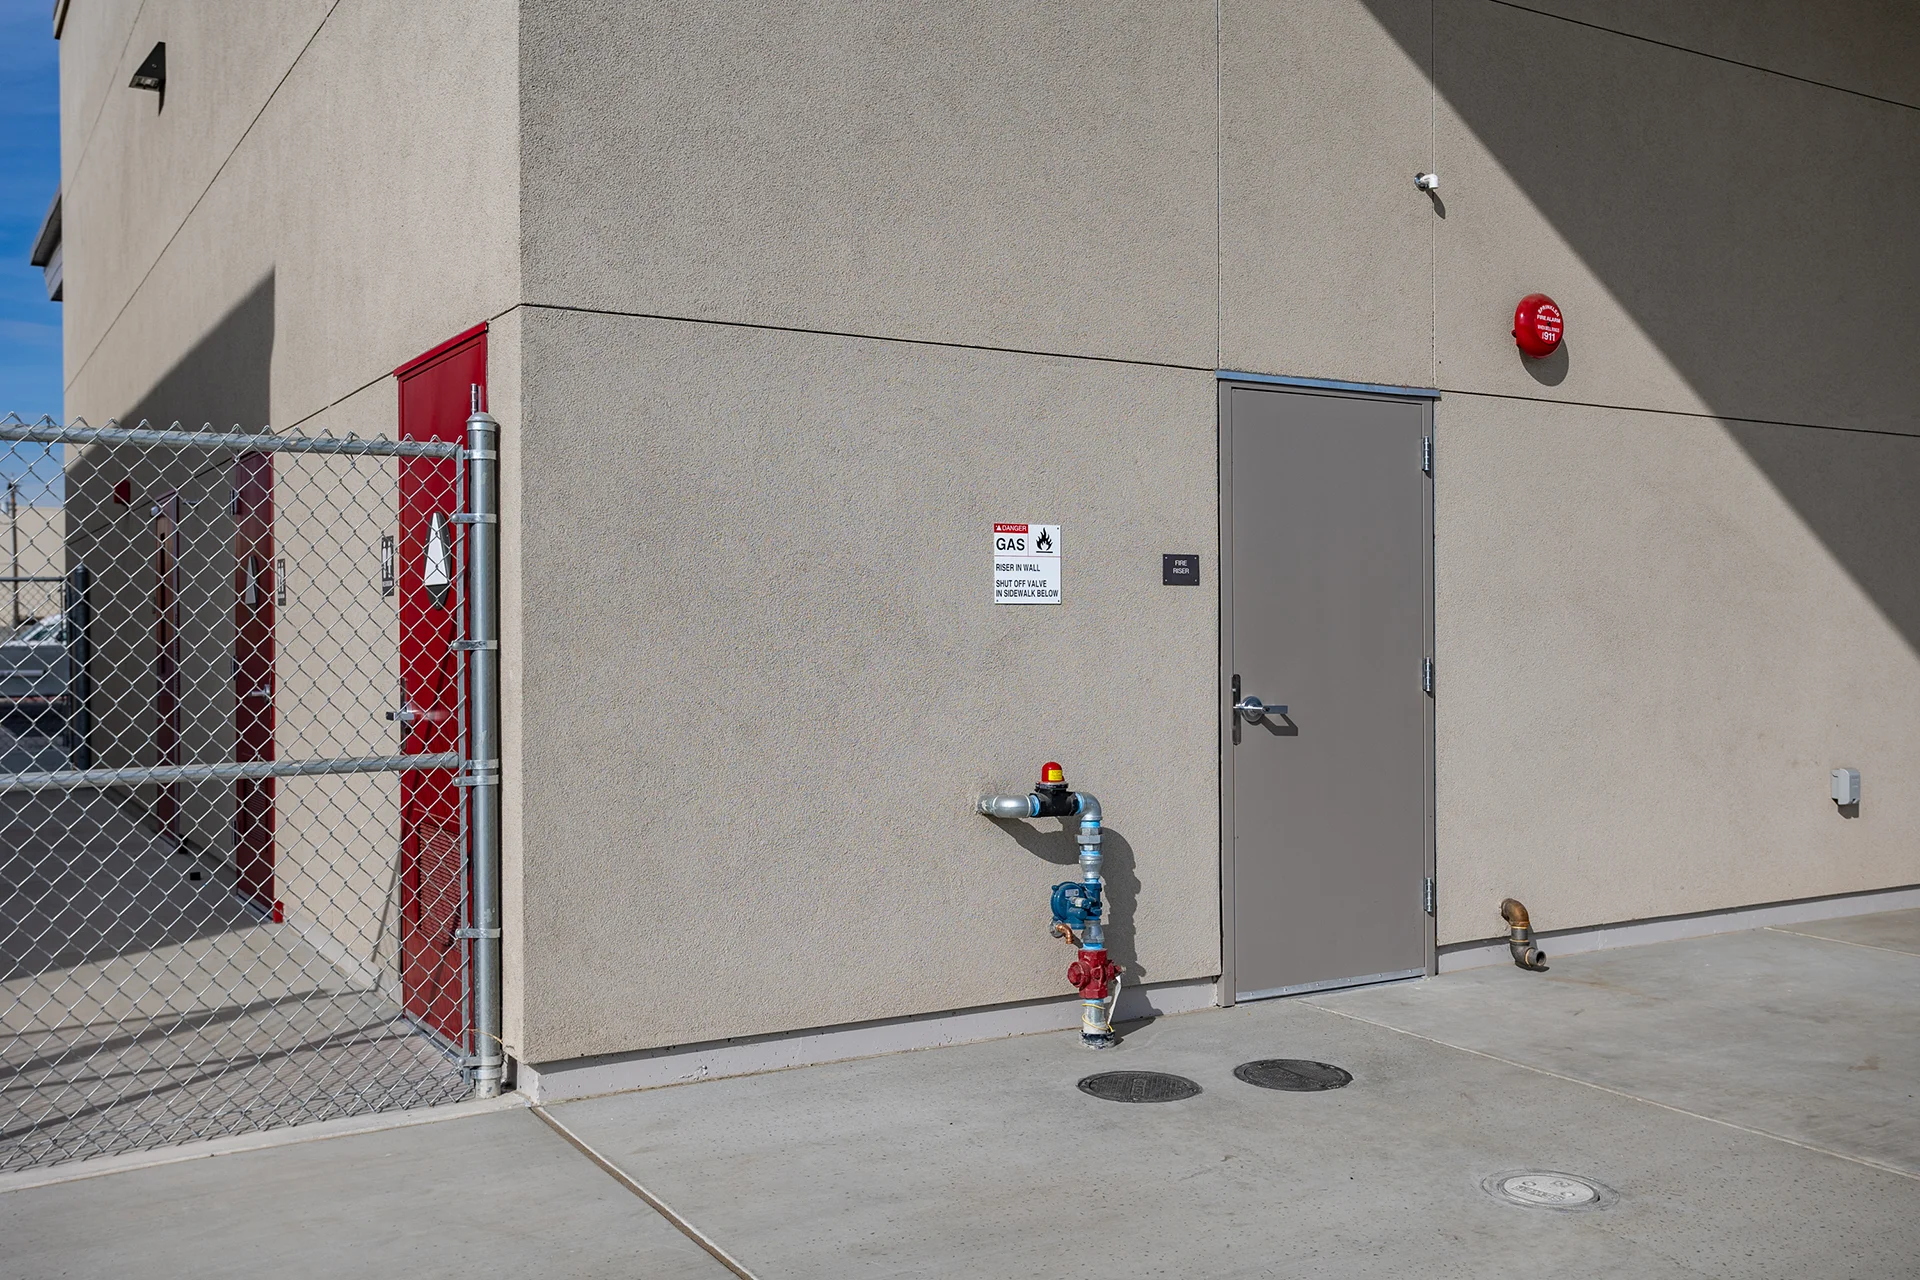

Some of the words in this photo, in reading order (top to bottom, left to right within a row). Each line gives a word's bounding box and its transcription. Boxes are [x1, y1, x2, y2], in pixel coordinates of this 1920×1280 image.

[1543, 332, 1555, 341] 911
[996, 537, 1025, 551] GAS
[996, 563, 1014, 571] RISER
